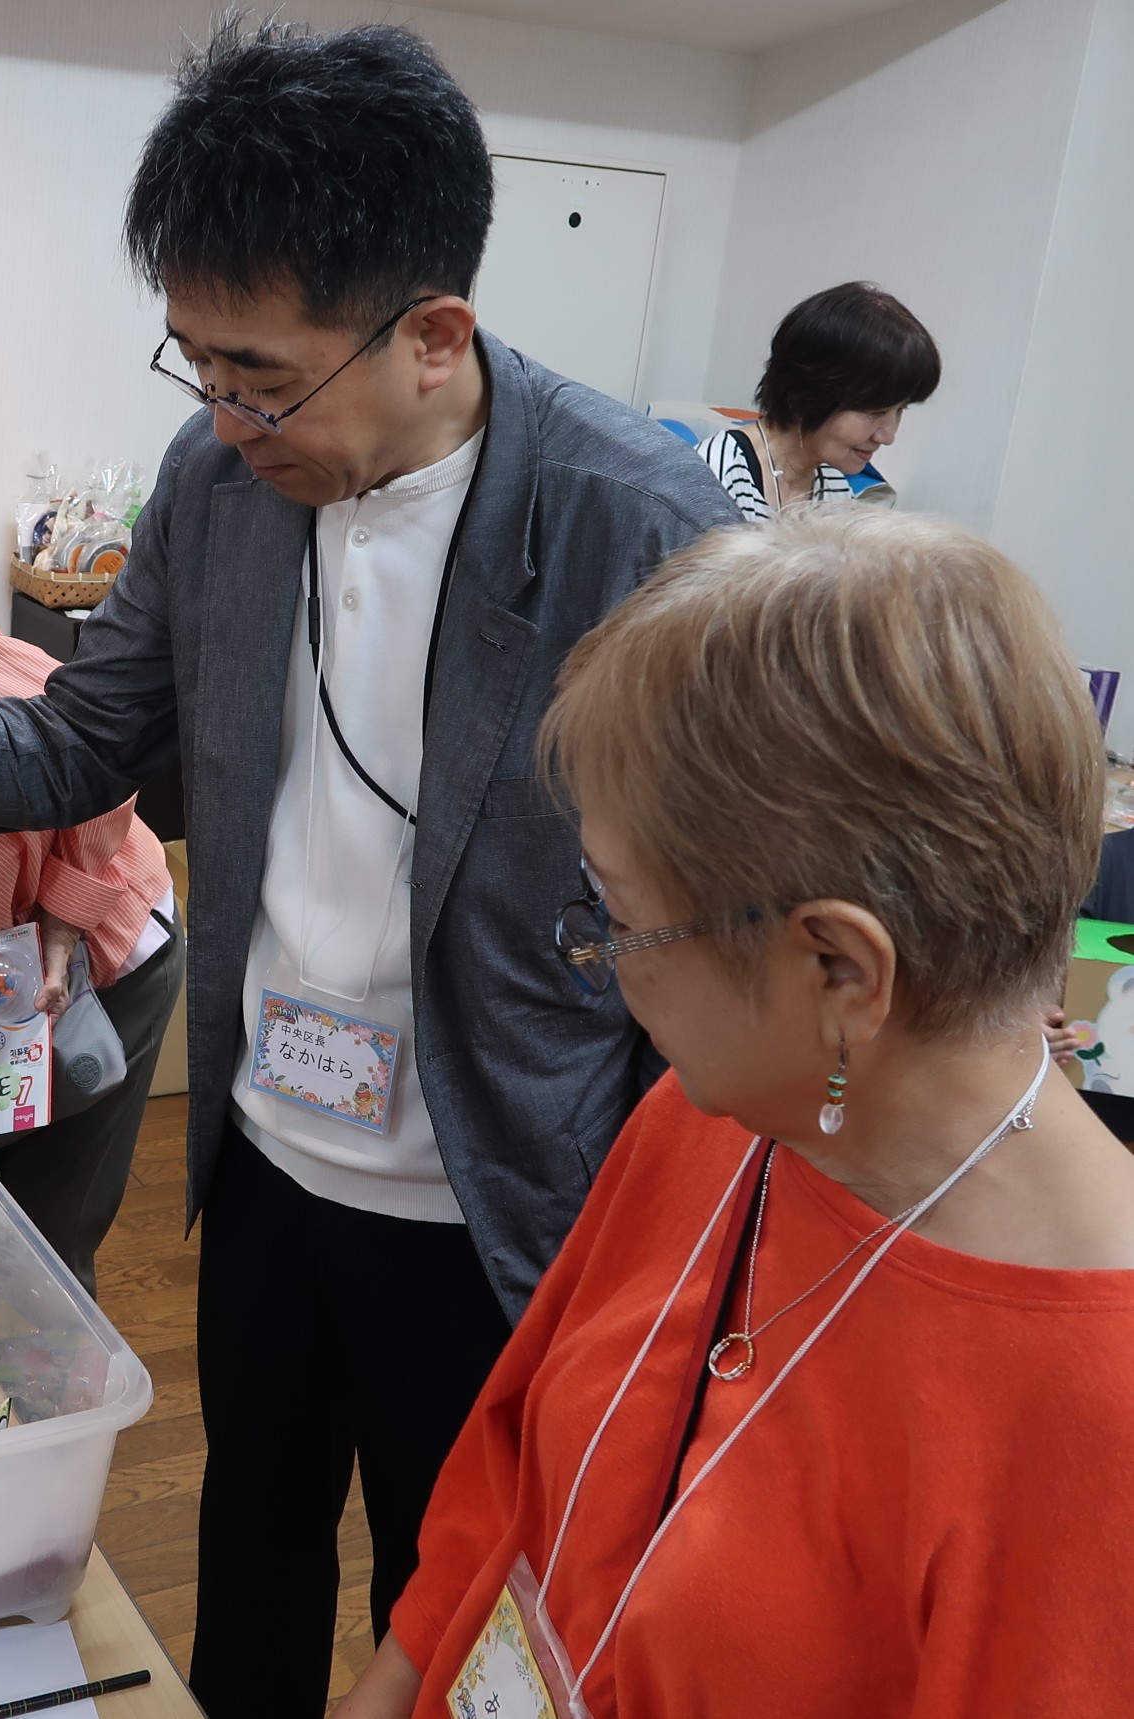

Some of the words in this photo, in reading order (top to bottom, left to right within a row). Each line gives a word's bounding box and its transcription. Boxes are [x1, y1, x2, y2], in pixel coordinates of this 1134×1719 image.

[281, 1024, 326, 1048] 中央区長
[279, 1041, 354, 1079] なかはら
